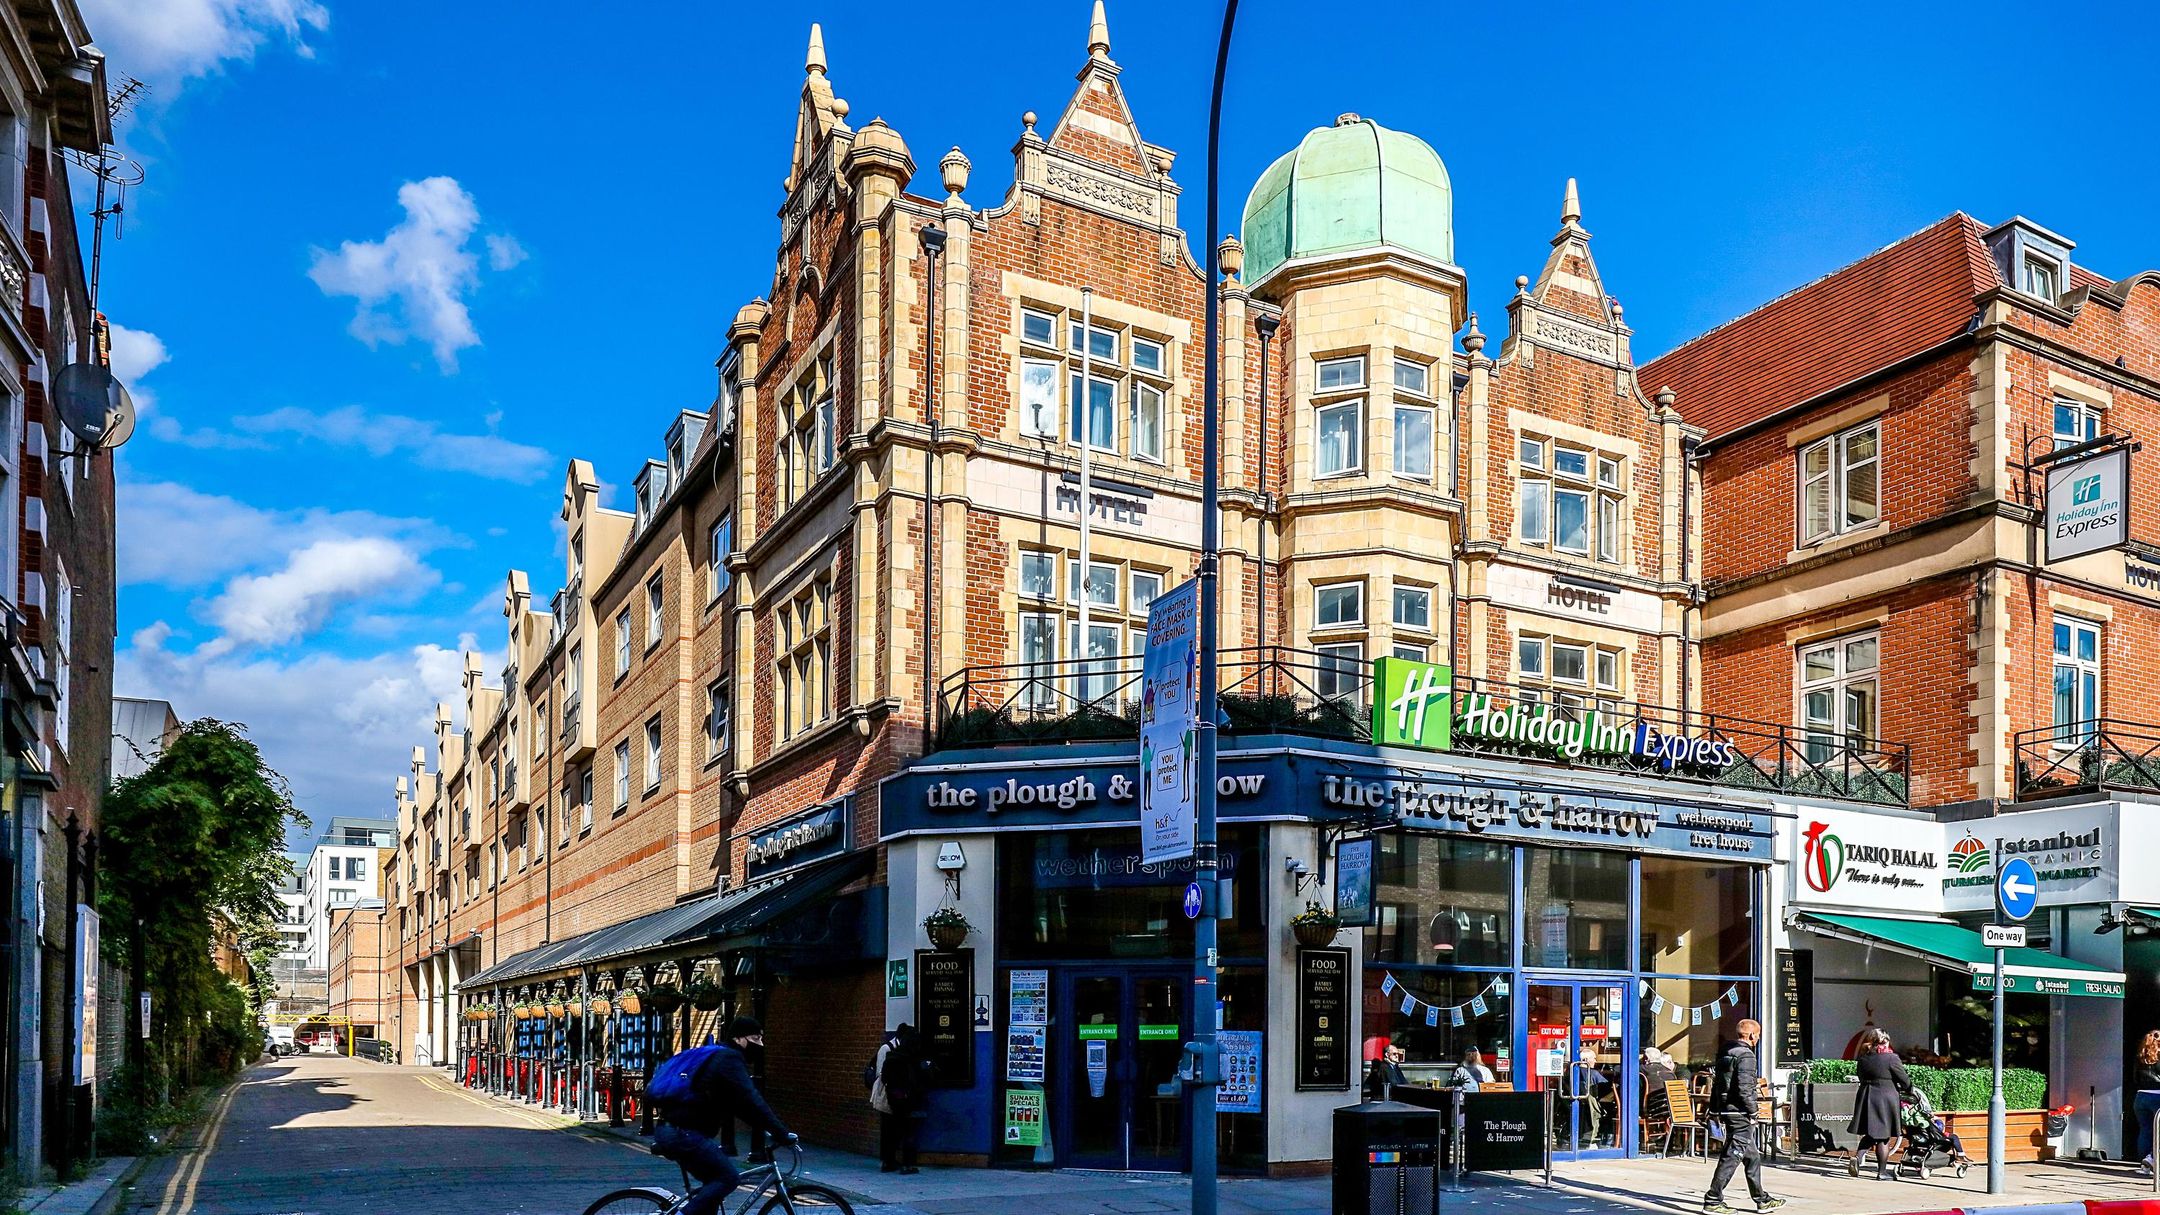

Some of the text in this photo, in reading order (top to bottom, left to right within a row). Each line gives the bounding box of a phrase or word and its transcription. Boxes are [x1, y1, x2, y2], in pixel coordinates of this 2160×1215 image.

[1056, 486, 1143, 526] HOTEL
[2056, 498, 2118, 523] Holiday Inn
[2055, 513, 2118, 539] Express
[1161, 598, 1187, 616] wearing
[1187, 595, 1192, 603] a
[1547, 583, 1608, 614] HOTEL
[1150, 608, 1194, 635] FACE MASK or
[1160, 678, 1180, 692] protect
[1164, 689, 1176, 700] YOU
[1461, 692, 1735, 770] Holiday Inn Express
[1162, 753, 1174, 764] YOU
[1157, 763, 1178, 776] protect
[1163, 775, 1172, 785] ME
[926, 774, 1133, 812] the plough &
[1322, 775, 1660, 837] the plough & harrow
[1155, 815, 1168, 829] h&f
[1692, 832, 1754, 851] free house
[1995, 827, 2101, 855] Istanbul
[1845, 844, 1938, 869] TARIQ HALAL
[2027, 849, 2101, 866] GANIC
[1340, 861, 1369, 870] HARROW
[1845, 868, 1870, 883] There
[1871, 873, 1880, 884] is
[1881, 873, 1900, 889] only
[1986, 929, 2022, 943] One way
[931, 961, 958, 970] FOOD
[1311, 960, 1336, 969] FOOD
[1976, 978, 1991, 987] HOT
[2045, 980, 2069, 988] Istanbul
[2085, 982, 2121, 994] FRESH SALAD
[1801, 1113, 1814, 1121] J.D.
[1484, 1121, 1527, 1131] The Plough
[1486, 1133, 1525, 1142] & Harrow
